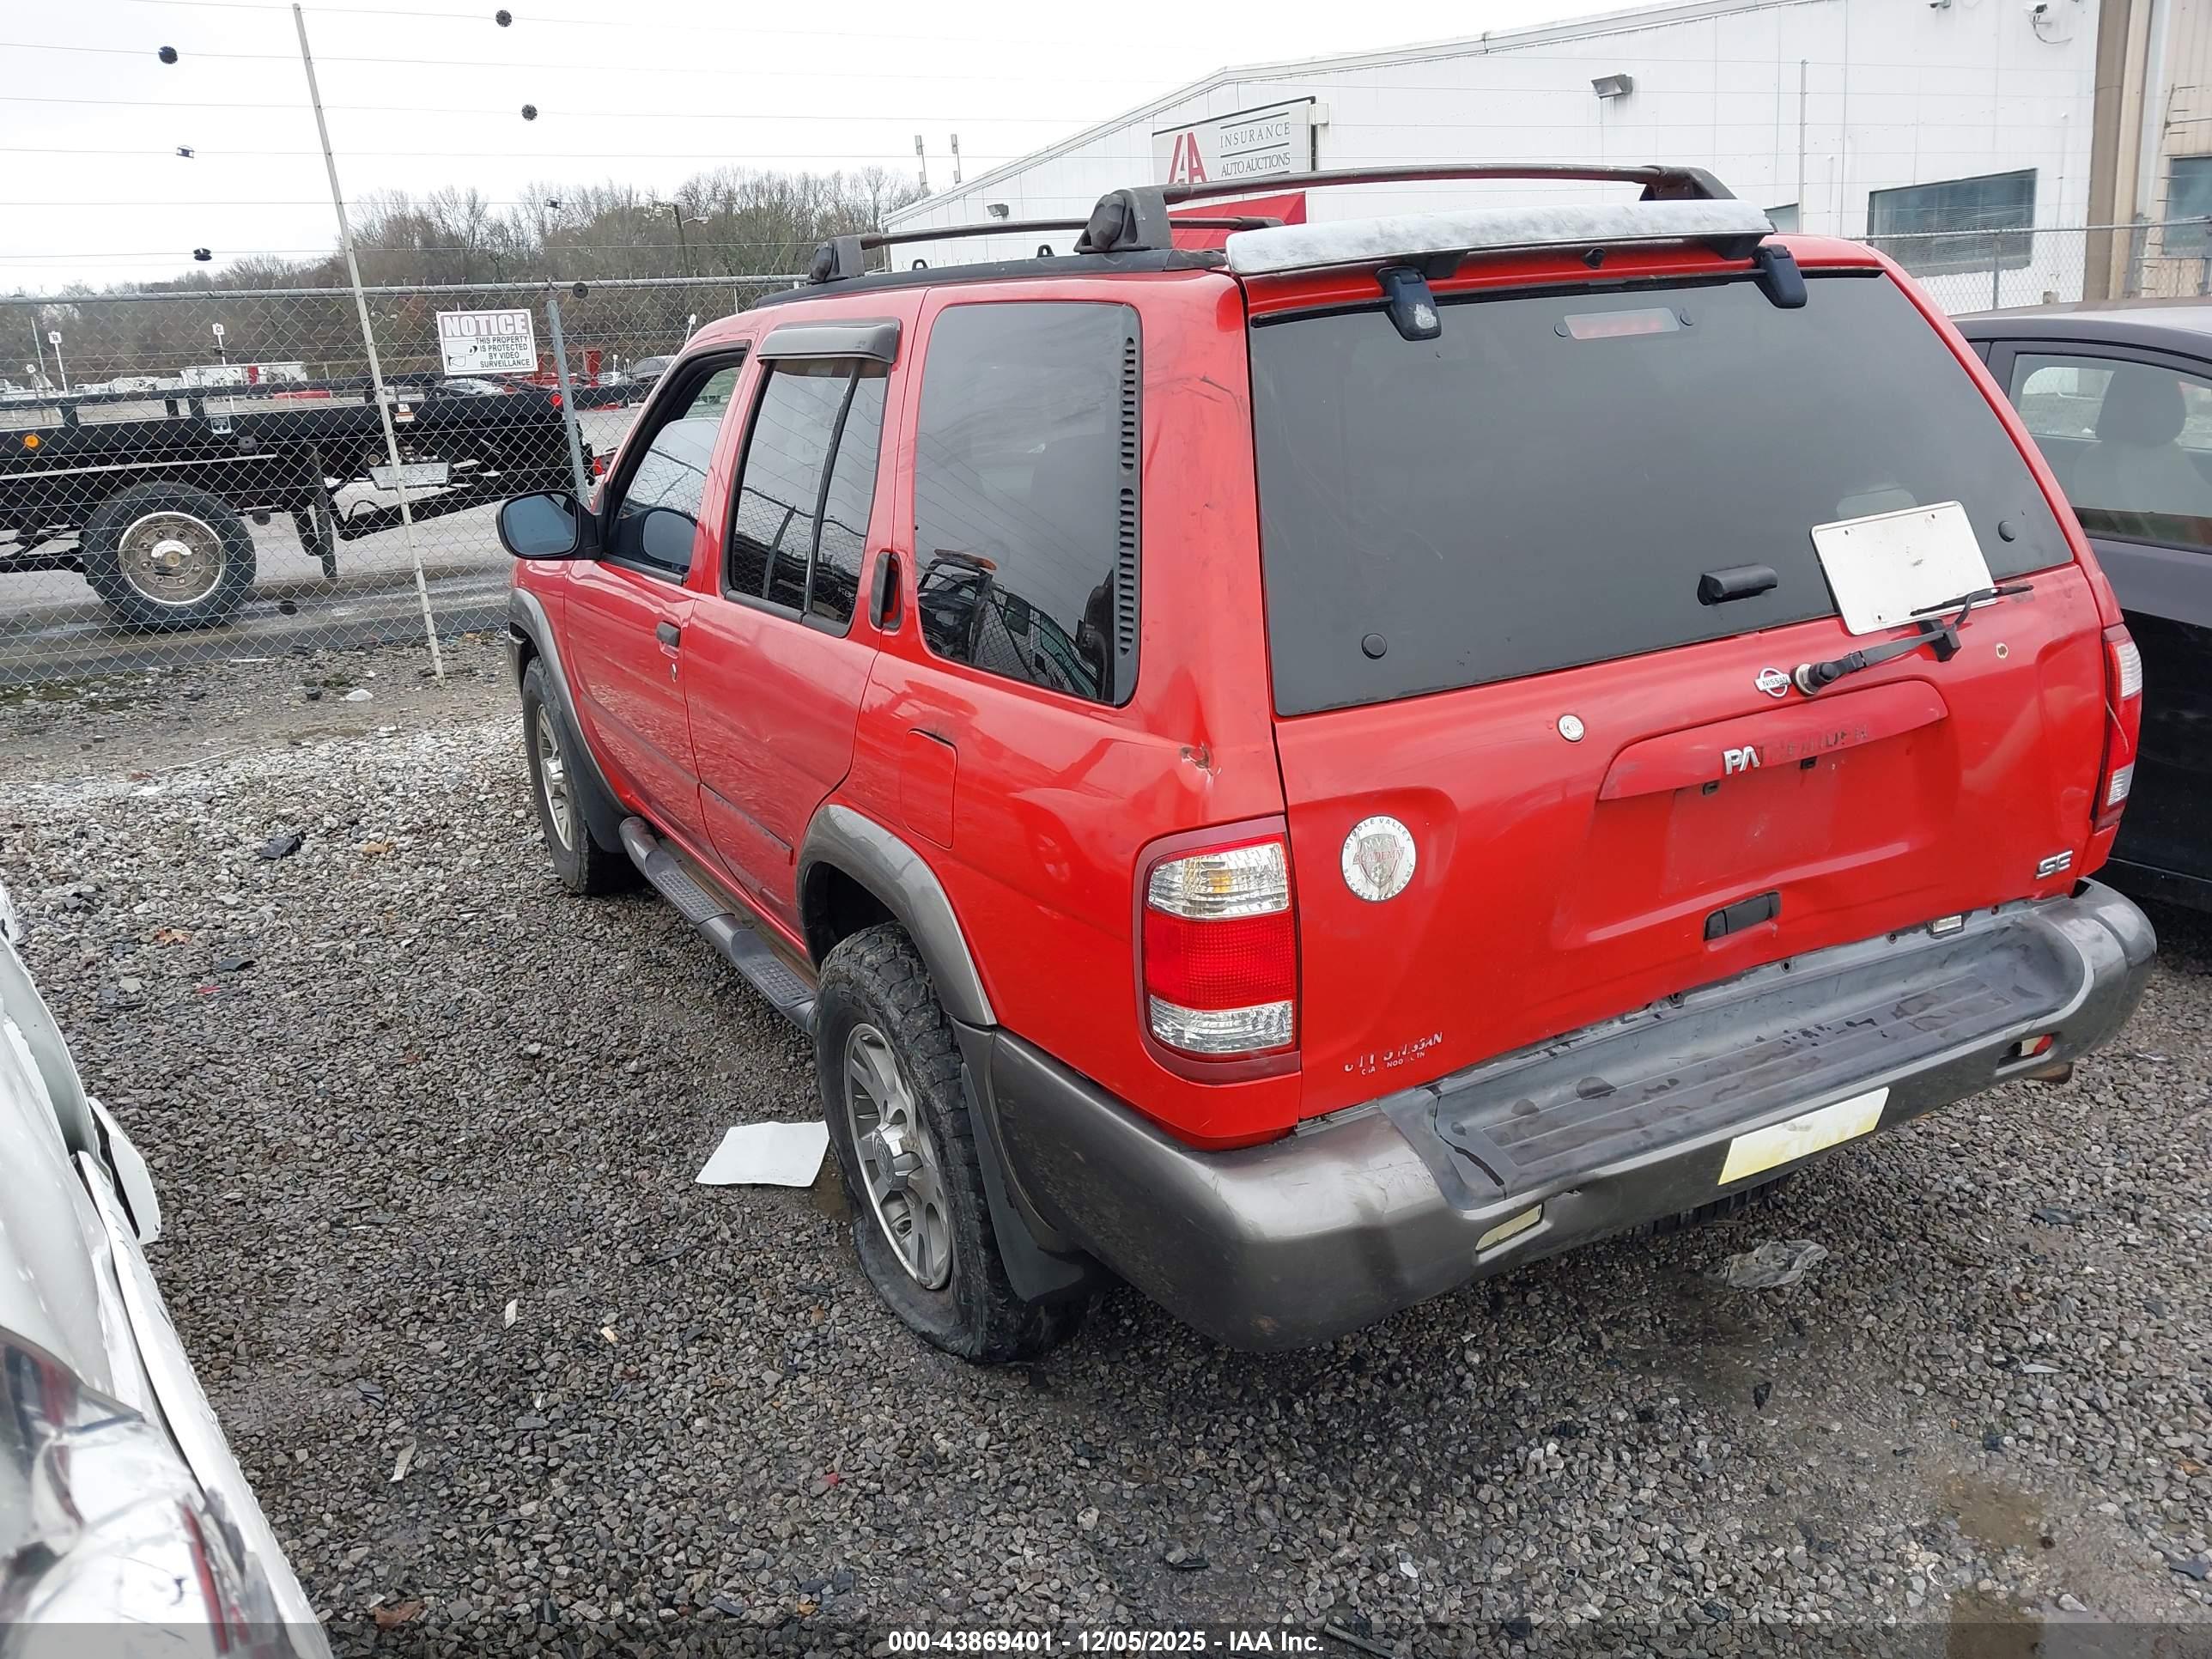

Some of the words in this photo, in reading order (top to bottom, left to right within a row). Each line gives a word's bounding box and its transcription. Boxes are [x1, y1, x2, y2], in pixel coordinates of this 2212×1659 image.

[1219, 122, 1291, 148] INSURANCE
[1221, 159, 1244, 177] AUTO
[1245, 152, 1291, 173] AUCTIONS
[443, 314, 527, 337] NOTICE
[488, 343, 528, 352] PROTECTED
[492, 335, 528, 344] PROPERTY
[480, 359, 531, 368] SURVEILLANCE
[499, 351, 520, 360] VIDEO
[1762, 676, 1789, 688] NISSAN
[1345, 818, 1375, 850] MIDDLE
[1379, 817, 1412, 842] VALLEY
[2036, 849, 2074, 880] SE
[1344, 868, 1373, 901] SOCCER
